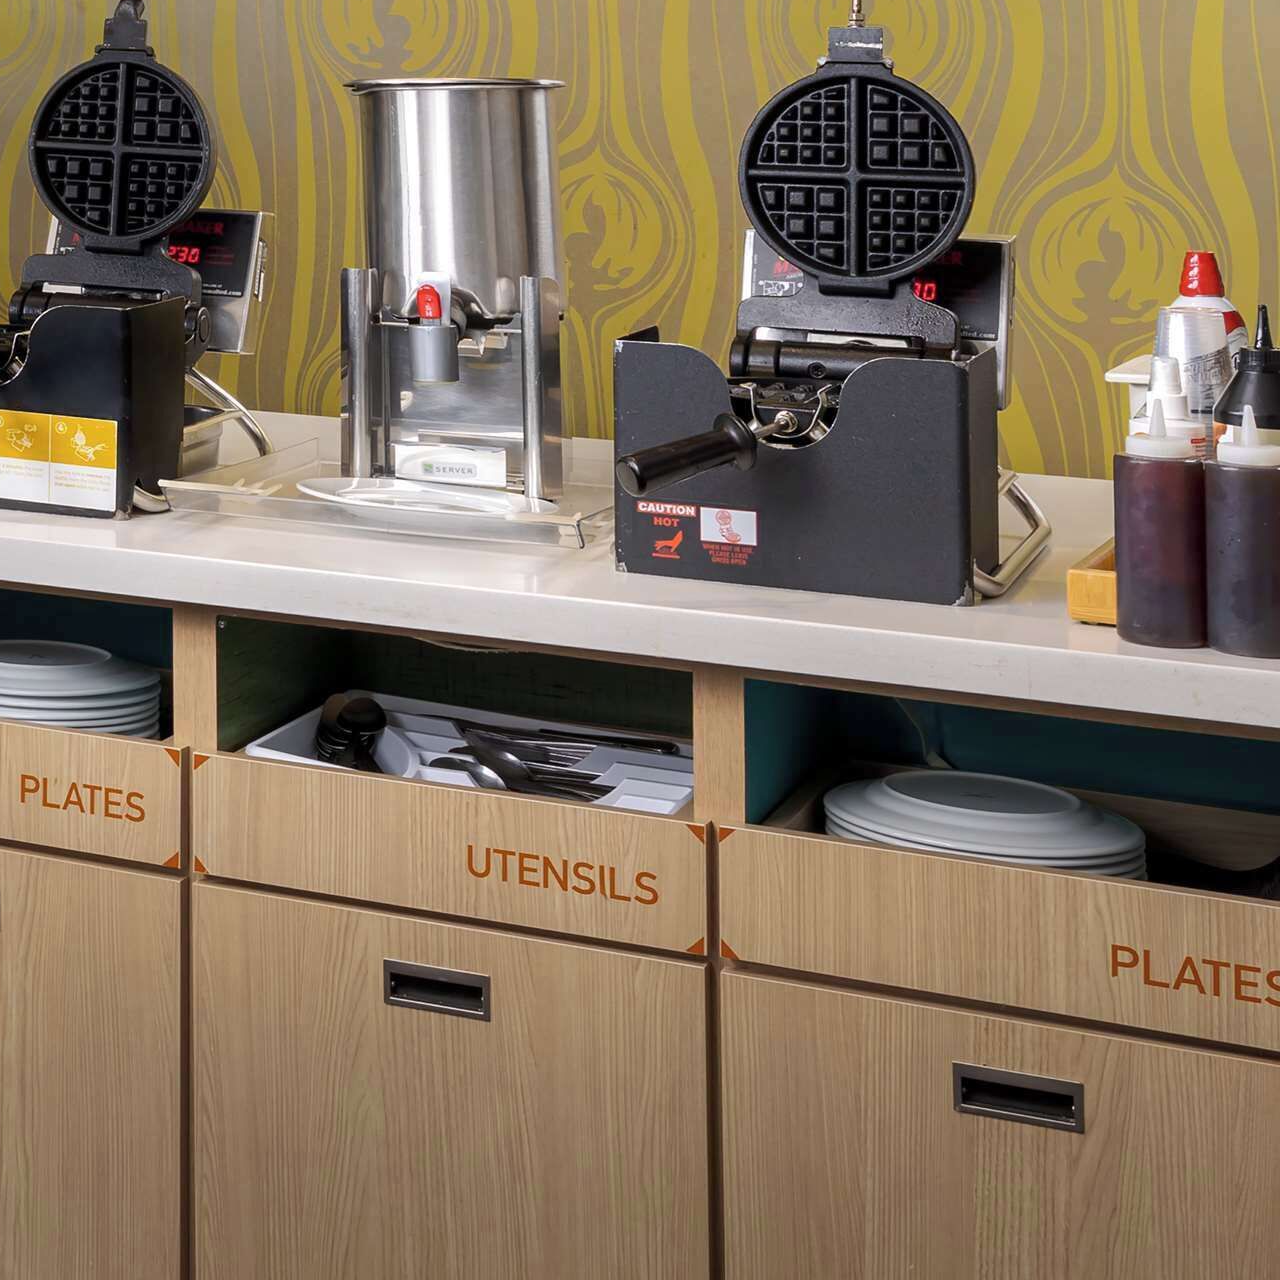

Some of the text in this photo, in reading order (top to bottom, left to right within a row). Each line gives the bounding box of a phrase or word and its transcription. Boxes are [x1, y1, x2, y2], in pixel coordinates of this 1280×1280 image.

[435, 465, 473, 474] SERVER
[638, 501, 696, 517] CAUTION
[653, 516, 680, 527] HOT
[18, 773, 147, 823] PLATES
[466, 843, 660, 906] UTENSILS
